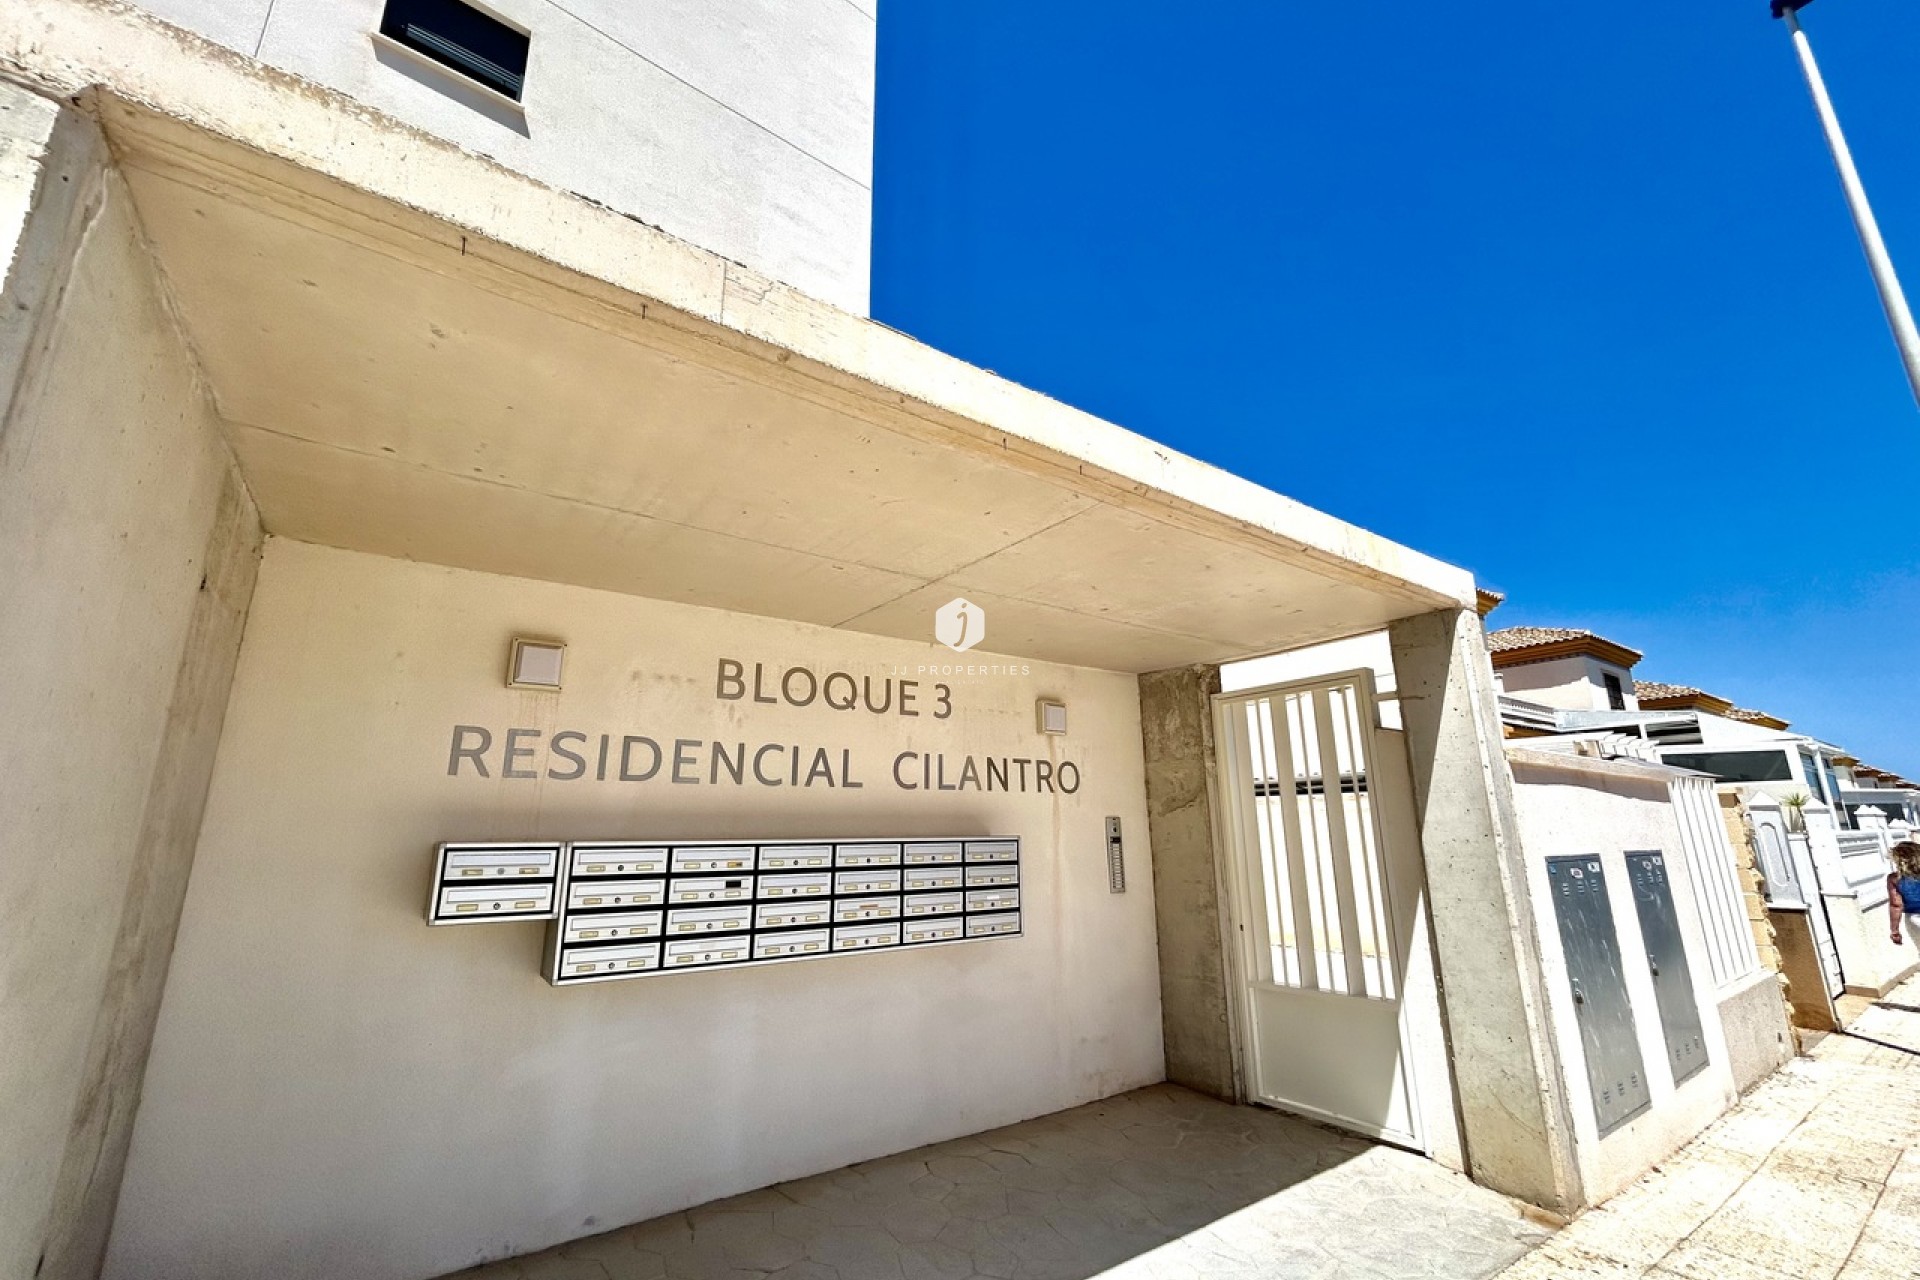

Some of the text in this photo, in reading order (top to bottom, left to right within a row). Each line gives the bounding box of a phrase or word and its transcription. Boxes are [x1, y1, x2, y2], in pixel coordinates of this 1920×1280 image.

[716, 657, 951, 719] BLOQUE 3
[447, 725, 1081, 794] RESIDENCIAL CILANTRO
